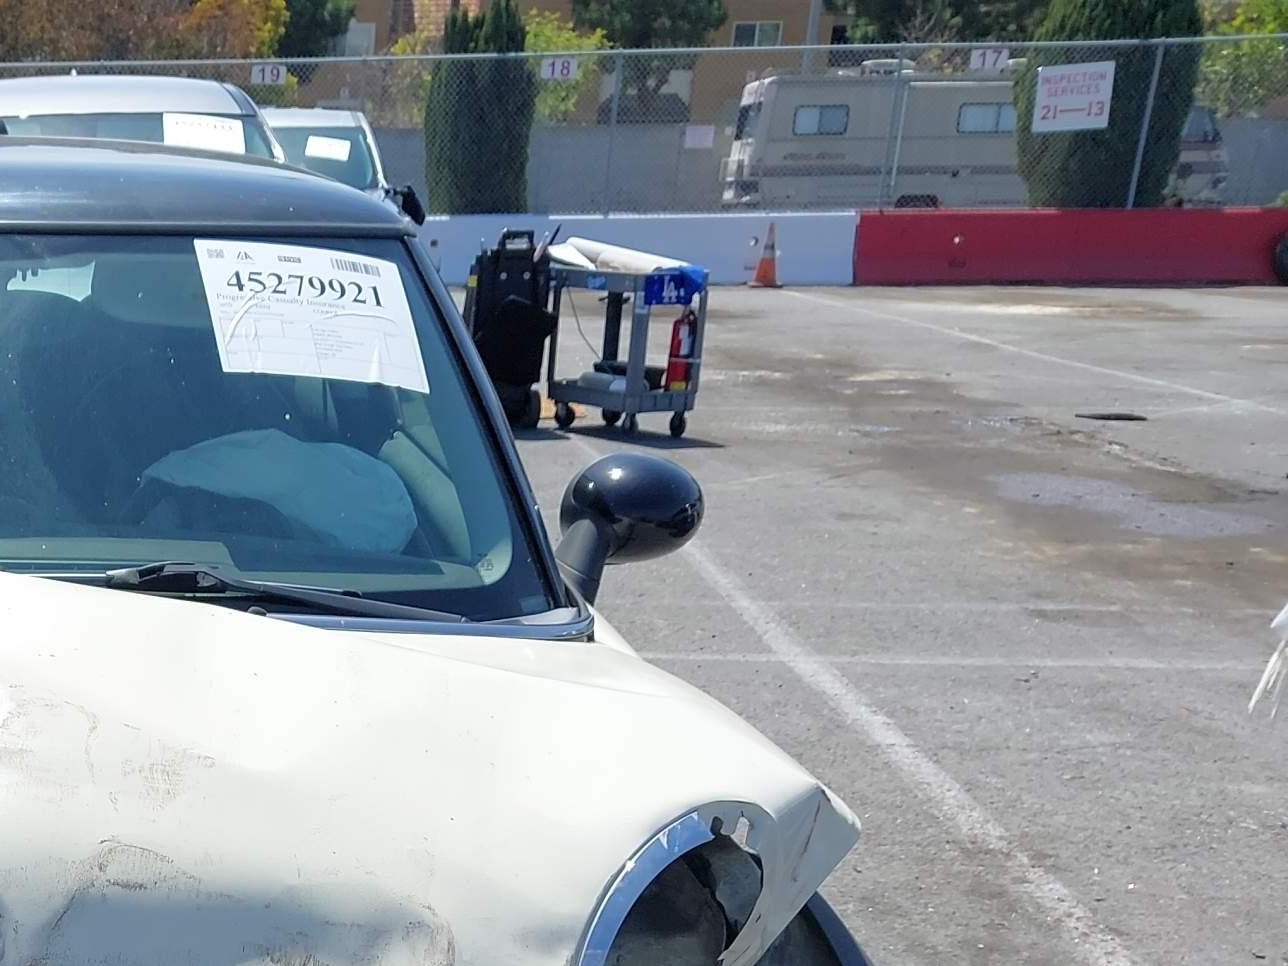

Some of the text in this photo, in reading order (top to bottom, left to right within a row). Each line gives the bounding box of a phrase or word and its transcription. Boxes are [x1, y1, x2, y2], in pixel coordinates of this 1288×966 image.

[979, 50, 1003, 67] 17
[257, 65, 281, 83] 19
[548, 59, 571, 77] 18
[226, 269, 384, 308] 45279921
[662, 274, 678, 304] LA
